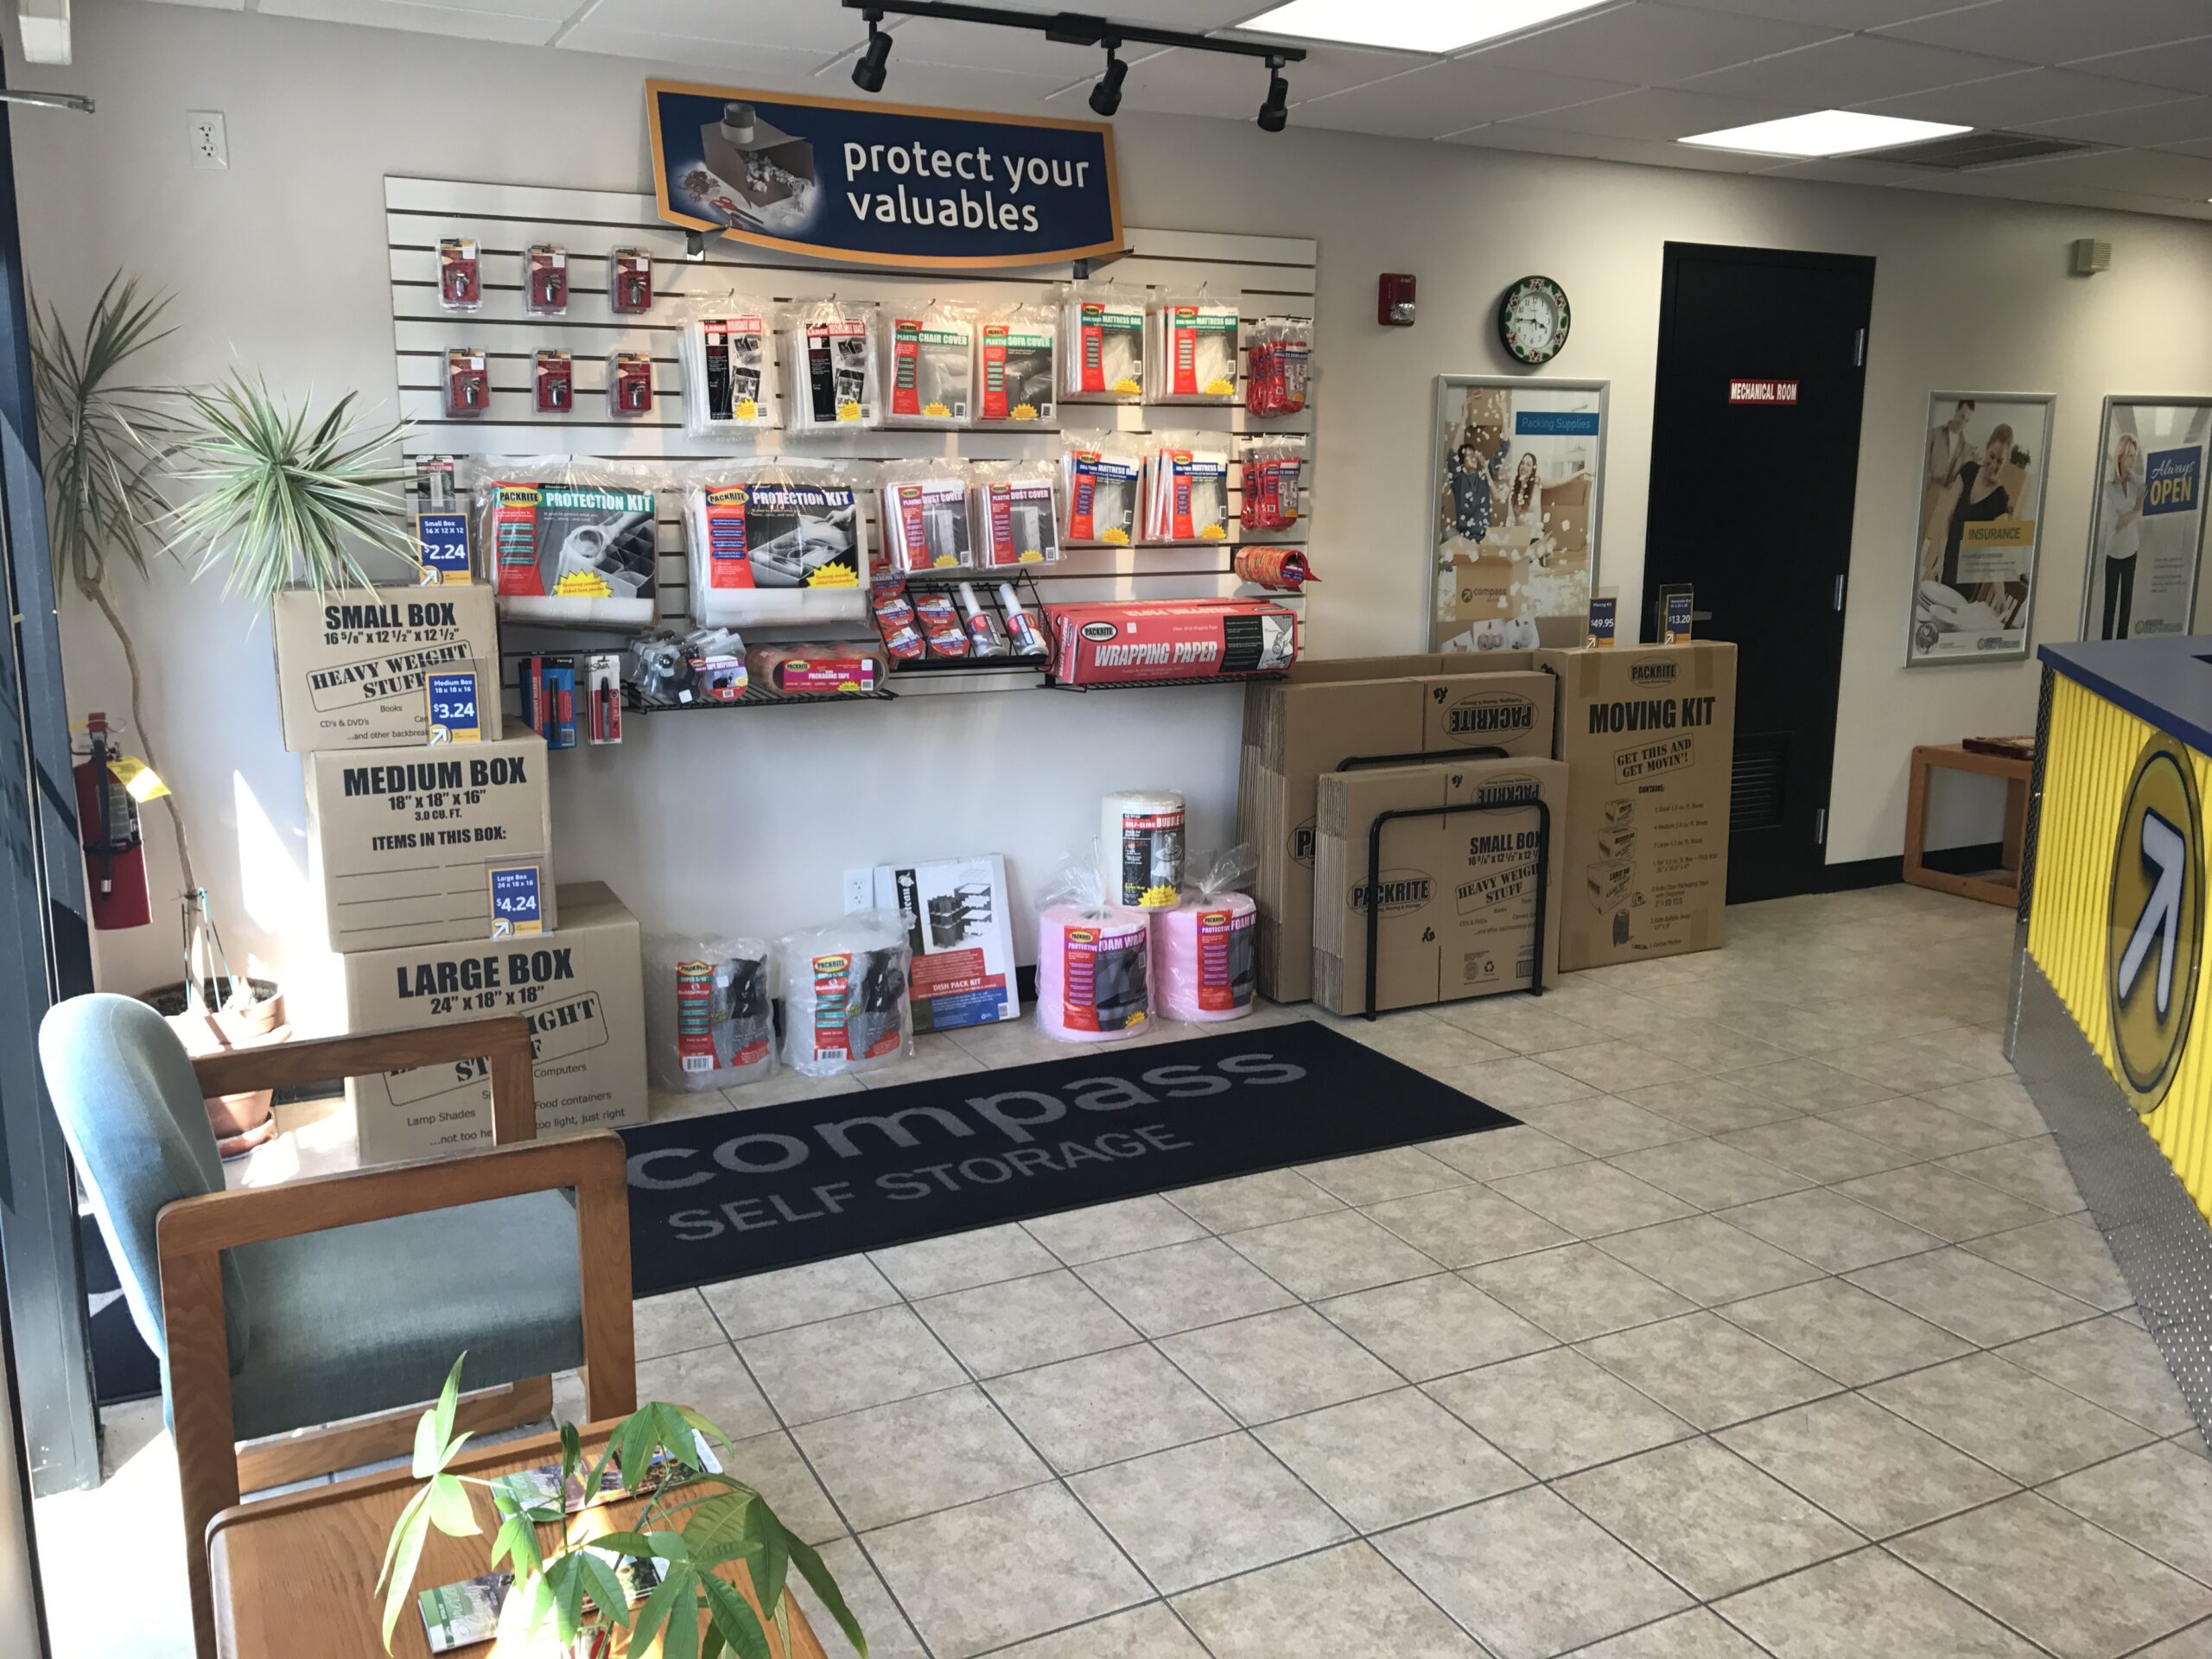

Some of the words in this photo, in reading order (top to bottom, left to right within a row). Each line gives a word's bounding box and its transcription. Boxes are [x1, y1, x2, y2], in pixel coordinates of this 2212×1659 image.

[844, 141, 994, 181] protect
[1003, 155, 1089, 193] your
[847, 185, 1039, 232] valuables
[1102, 315, 1130, 324] MATTRESS
[919, 333, 941, 343] CHAIR
[943, 335, 967, 345] COVER
[1008, 337, 1025, 346] SOFA
[1027, 337, 1050, 346] COVER
[1731, 383, 1774, 400] MECHANICAL
[1777, 384, 1797, 400] ROOM
[1521, 418, 1554, 431] Packing
[1556, 418, 1590, 431] Supplies
[1098, 465, 1125, 474] MATTRESS
[2151, 460, 2195, 479] Always
[500, 492, 538, 501] PACKRITE
[710, 493, 745, 502] PACKRITE
[753, 491, 824, 505] PROTECTION
[827, 491, 848, 506] KIT
[923, 496, 939, 504] DUST
[941, 493, 963, 502] COVER
[1011, 491, 1027, 500] DUST
[1029, 490, 1048, 498] COVER
[2150, 477, 2191, 505] OPEN
[546, 493, 623, 511] PROTECTION
[627, 495, 651, 512] KIT
[1969, 528, 2020, 540] INSURANCE
[425, 544, 465, 559] $2.24
[1474, 588, 1506, 597] compass
[325, 604, 403, 630] SMALL
[409, 603, 456, 627] BOX
[1591, 618, 1614, 627] $49.95
[1669, 615, 1690, 624] $13.20
[324, 633, 338, 644] 16
[377, 631, 389, 642] 12
[424, 629, 436, 640] 12
[1085, 627, 1113, 636] PACKRITE
[1095, 643, 1170, 667] WRAPPING
[1172, 641, 1217, 663] PAPER
[311, 663, 379, 690] HEAVY
[386, 644, 467, 675] WEIGHT
[717, 661, 738, 669] DISPENSER
[1632, 665, 1675, 679] PACKRITE
[434, 703, 474, 719] $3.24
[1452, 705, 1532, 732] PACKRITE
[1589, 698, 1677, 734] MOVING
[1682, 697, 1715, 727] KIT
[1617, 750, 1640, 766] GET
[1642, 744, 1668, 761] THIS
[1670, 738, 1692, 755] AND
[1622, 761, 1644, 779] GET
[1647, 752, 1688, 775] MOVIN'!
[343, 761, 462, 796] MEDIUM
[470, 757, 527, 786] BOX
[415, 797, 423, 808] x
[453, 795, 461, 805] x
[415, 811, 430, 821] 3.0
[432, 810, 448, 820] CU.
[449, 808, 462, 818] FT.
[1157, 816, 1179, 827] BUBBLE
[373, 834, 416, 851] ITEMS
[420, 832, 435, 846] IN
[438, 829, 471, 845] THIS
[475, 826, 506, 842] BOX:
[1470, 834, 1513, 855] SMALL
[1458, 877, 1496, 899] HEAVY
[1486, 882, 1522, 904] STUFF
[496, 896, 536, 912] $4.24
[1201, 925, 1230, 933] PROTECTIVE
[1231, 917, 1250, 931] FOAM
[1068, 943, 1098, 952] PROTECTIVE
[1099, 938, 1123, 952] FOAM
[1124, 932, 1145, 947] WRAP
[817, 960, 844, 969] PACKRITE
[397, 956, 501, 998] LARGE
[508, 948, 574, 985] BOX
[933, 981, 949, 991] DISH
[951, 979, 968, 988] PACK
[970, 978, 981, 986] KIT
[462, 999, 473, 1011] x
[506, 993, 515, 1005] x
[529, 999, 595, 1035] IGHT
[534, 1063, 587, 1079] Computers
[535, 1099, 559, 1110] Food
[561, 1091, 612, 1107] containers
[407, 1114, 436, 1126] Lamp
[439, 1109, 475, 1122] Shades
[460, 1131, 477, 1141] too
[554, 1115, 578, 1128] light,
[581, 1112, 600, 1125] just
[603, 1108, 625, 1122] right
[626, 1053, 1307, 1190] compass
[668, 1181, 855, 1242] SELF
[875, 1123, 1193, 1201] STORAGE
